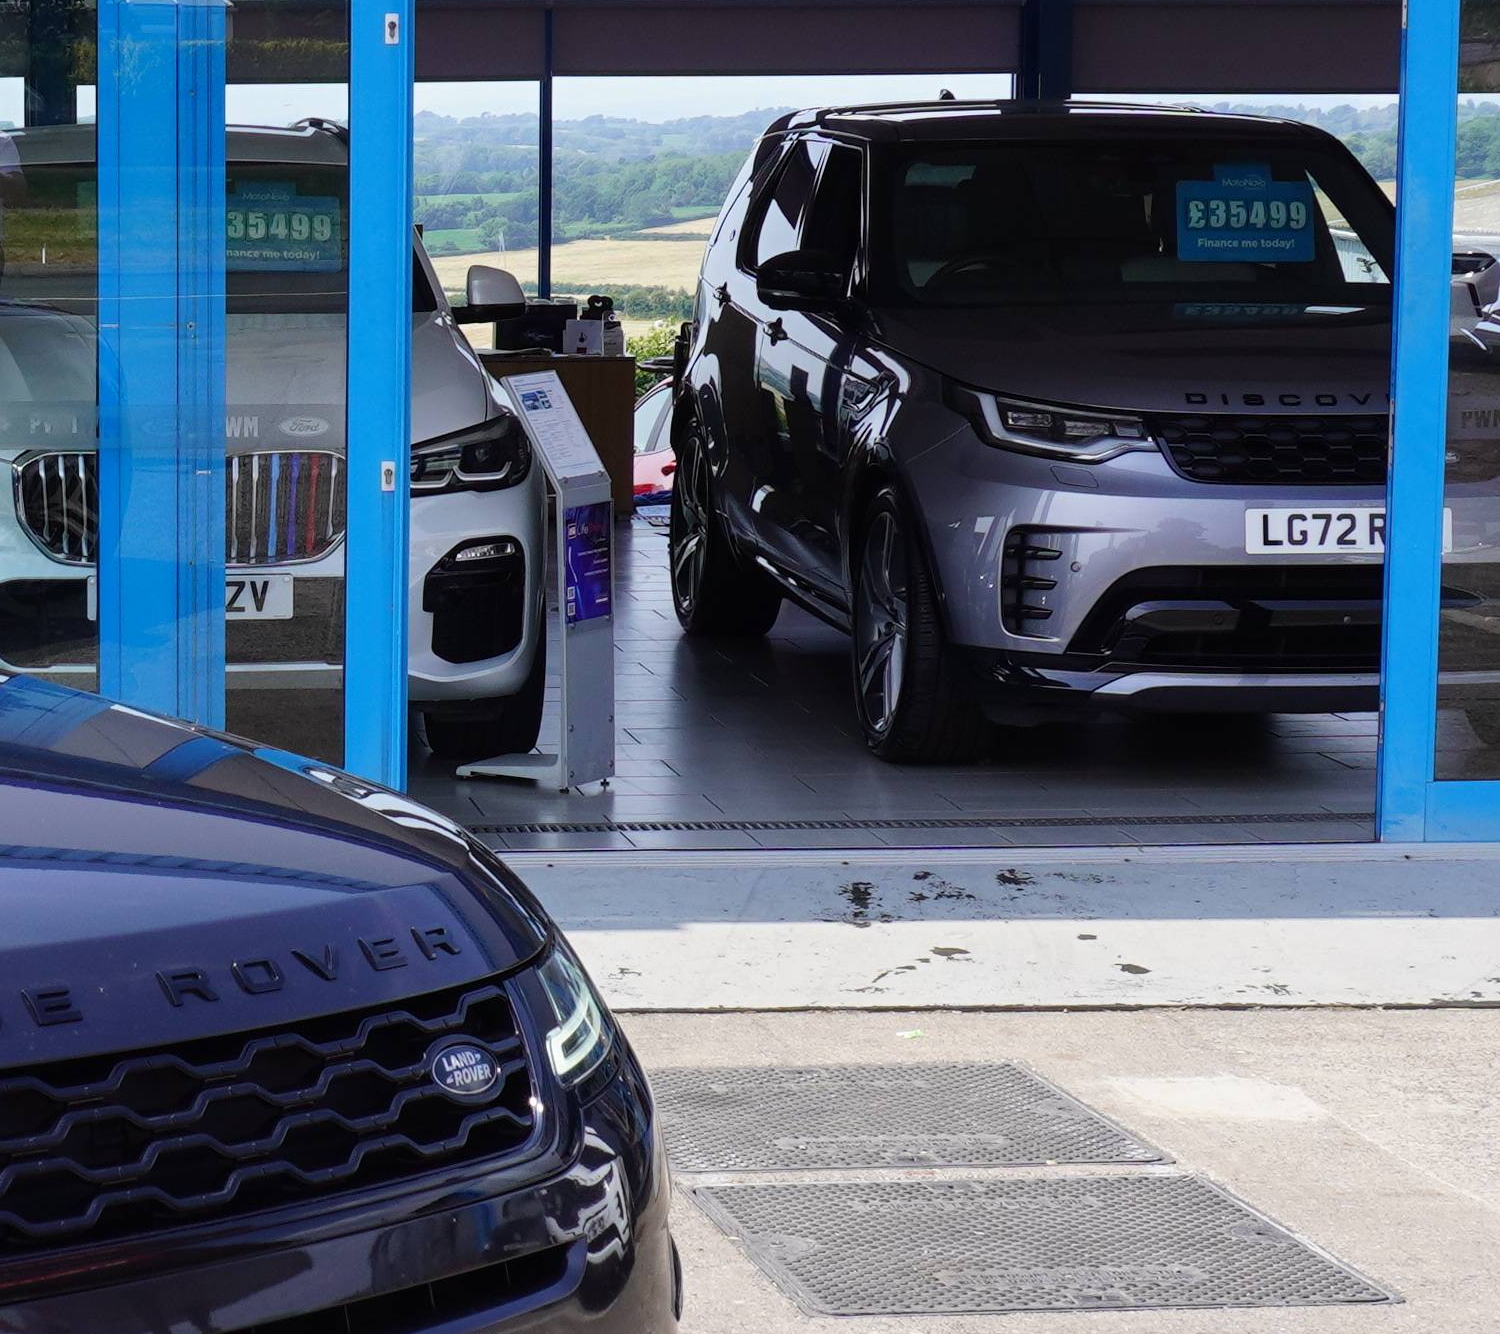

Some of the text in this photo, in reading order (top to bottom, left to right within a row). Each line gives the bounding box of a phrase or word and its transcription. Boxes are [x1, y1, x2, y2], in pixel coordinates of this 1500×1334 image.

[227, 211, 332, 241] 35499
[1188, 200, 1307, 229] £35499
[227, 248, 259, 258] nance
[1198, 238, 1296, 250] Finance me today!
[1185, 392, 1391, 406] DISCOV
[226, 416, 259, 437] WM
[1262, 513, 1357, 547] LG72
[226, 580, 269, 613] ZV
[155, 926, 462, 1008] ROVER
[442, 1051, 476, 1072] LAND
[453, 1063, 493, 1087] ROVER
